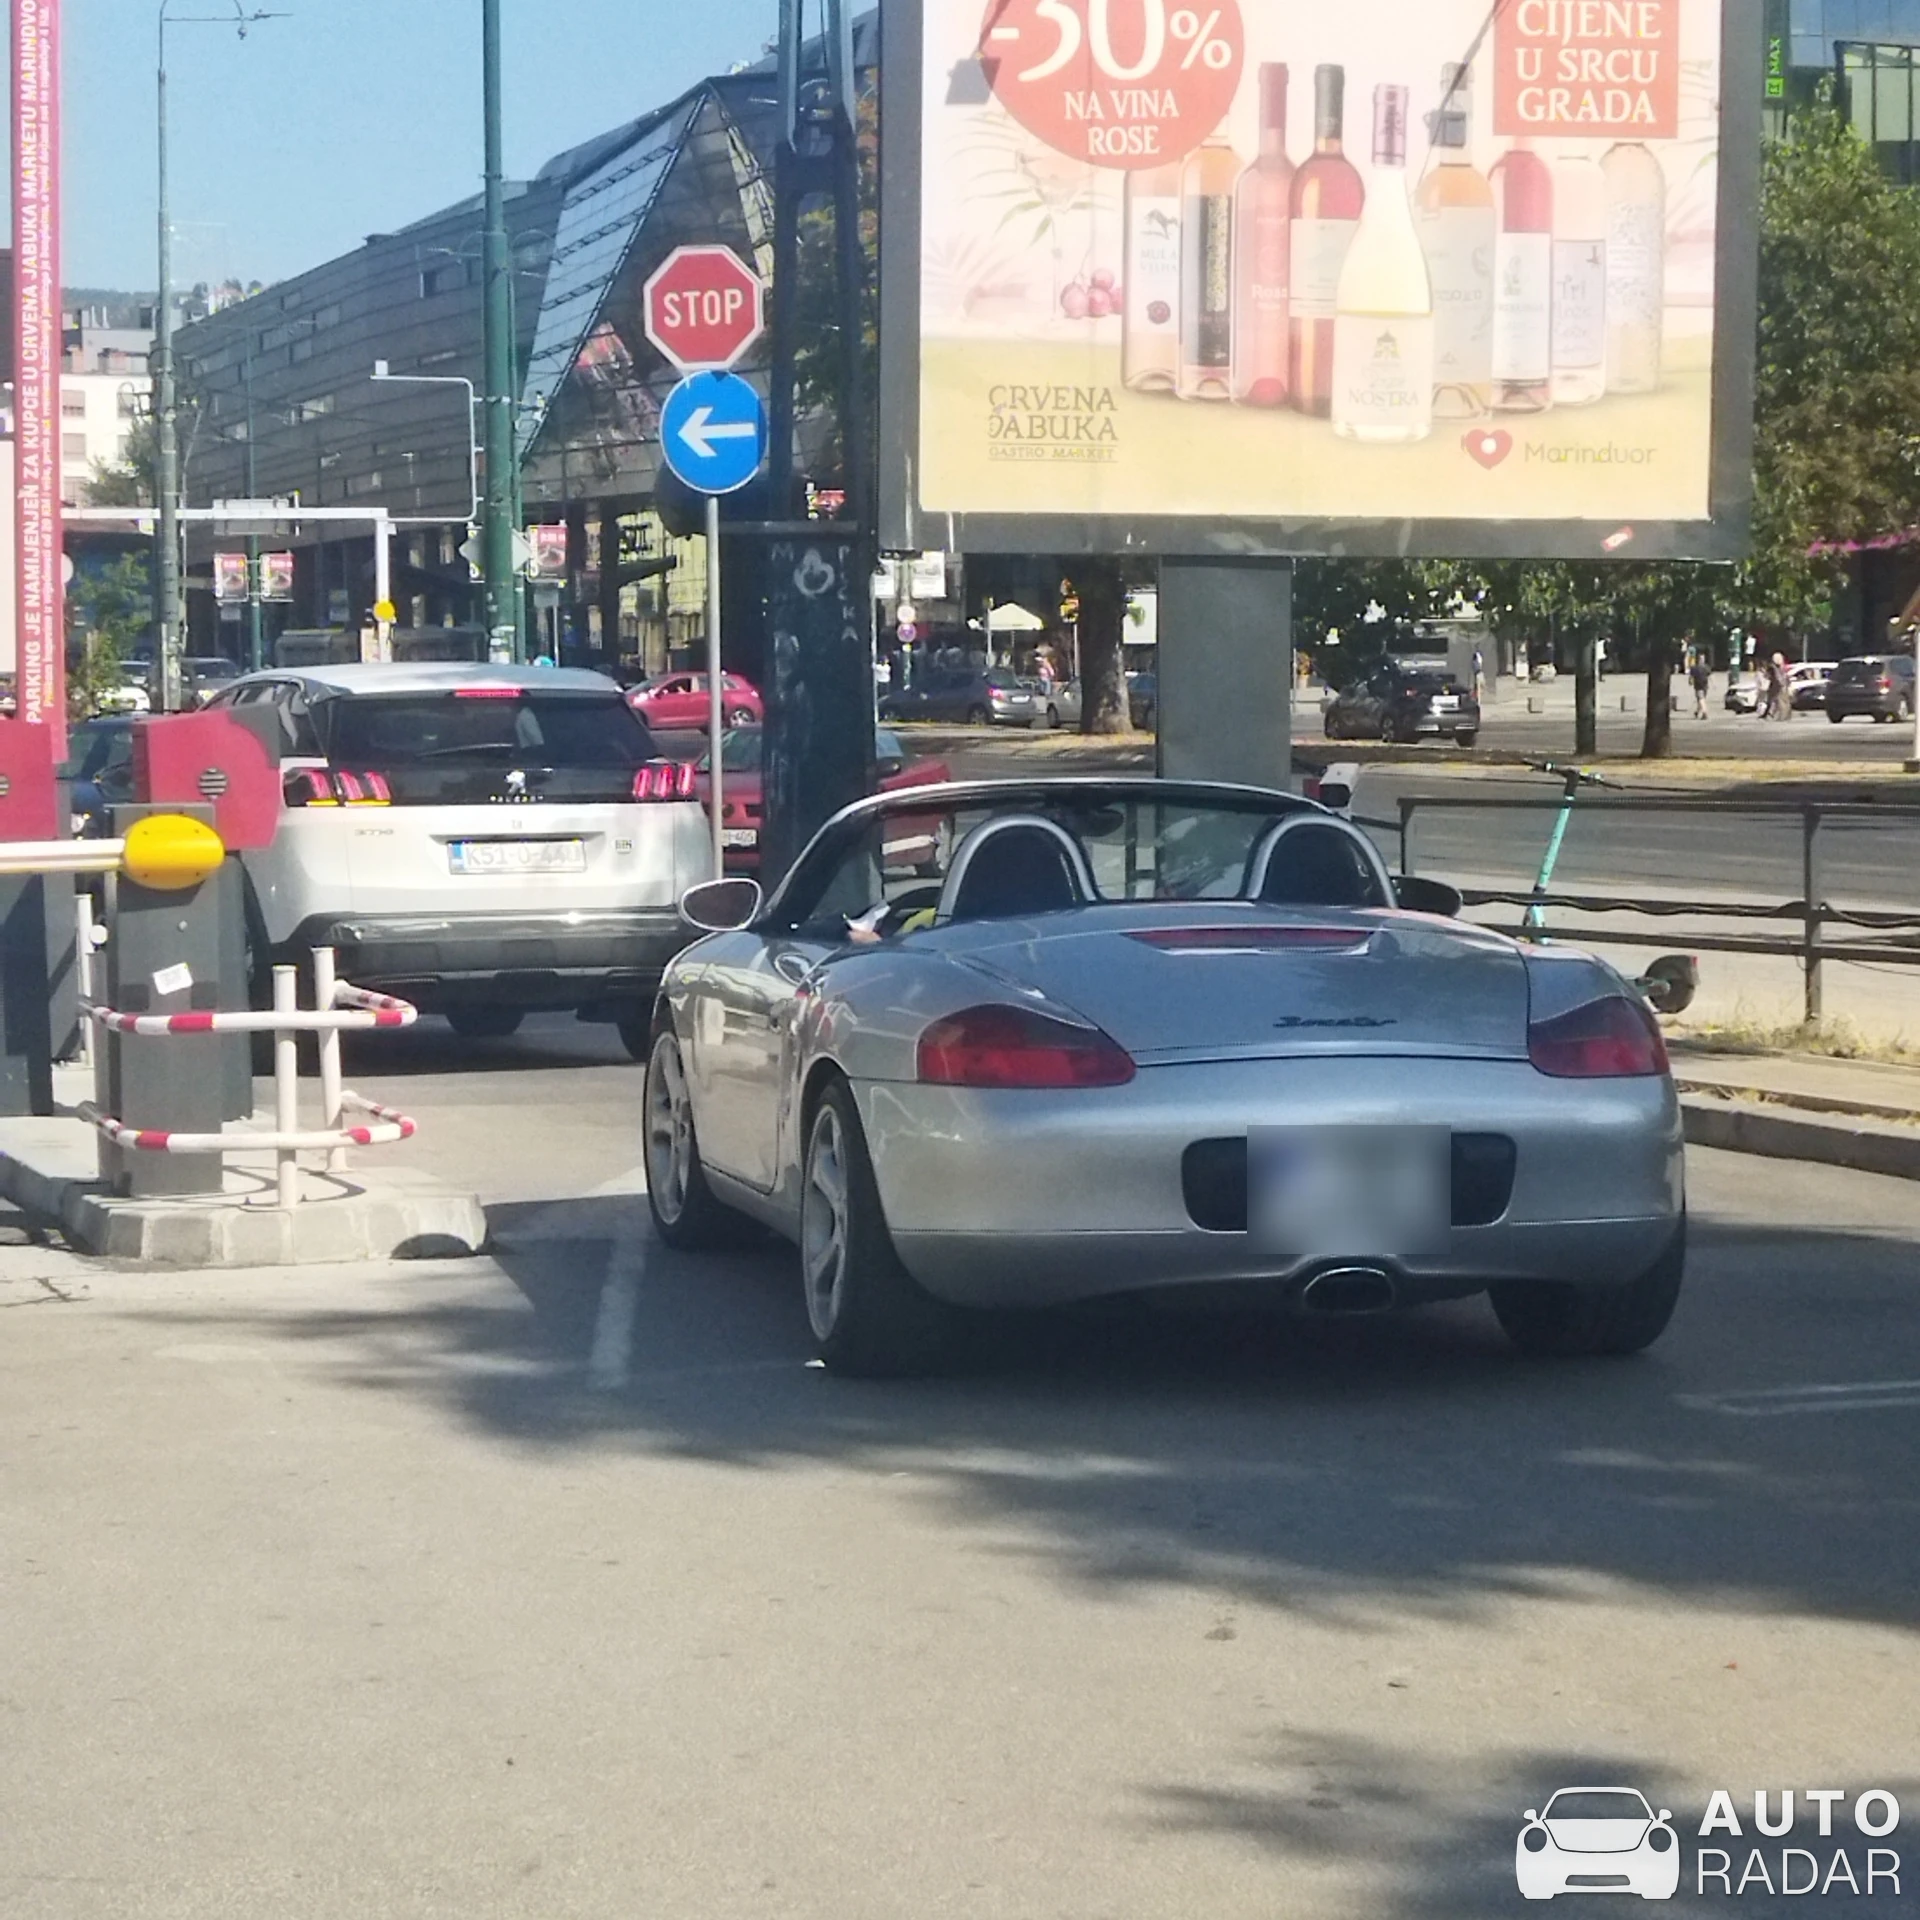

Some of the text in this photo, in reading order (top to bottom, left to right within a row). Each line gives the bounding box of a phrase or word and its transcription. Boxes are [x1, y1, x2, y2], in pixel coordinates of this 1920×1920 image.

[1516, 0, 1662, 46] CIJENE
[1515, 47, 1660, 84] U SRCU
[1064, 89, 1180, 120] NA VINA
[1516, 87, 1657, 124] GRADA
[21, 106, 38, 199] MARKETU
[1088, 125, 1161, 156] ROSE
[22, 204, 38, 280] JABUKA
[22, 285, 39, 361] CRVENA
[663, 287, 743, 328] STOP
[23, 367, 39, 380] U
[988, 384, 1119, 412] CRVENA
[1347, 388, 1419, 407] NOSTRA
[23, 385, 40, 448] KUPCE
[23, 454, 40, 479] ZA
[24, 485, 40, 608] NAMIJENJEN
[25, 612, 41, 636] JE
[25, 641, 41, 723] PARKING
